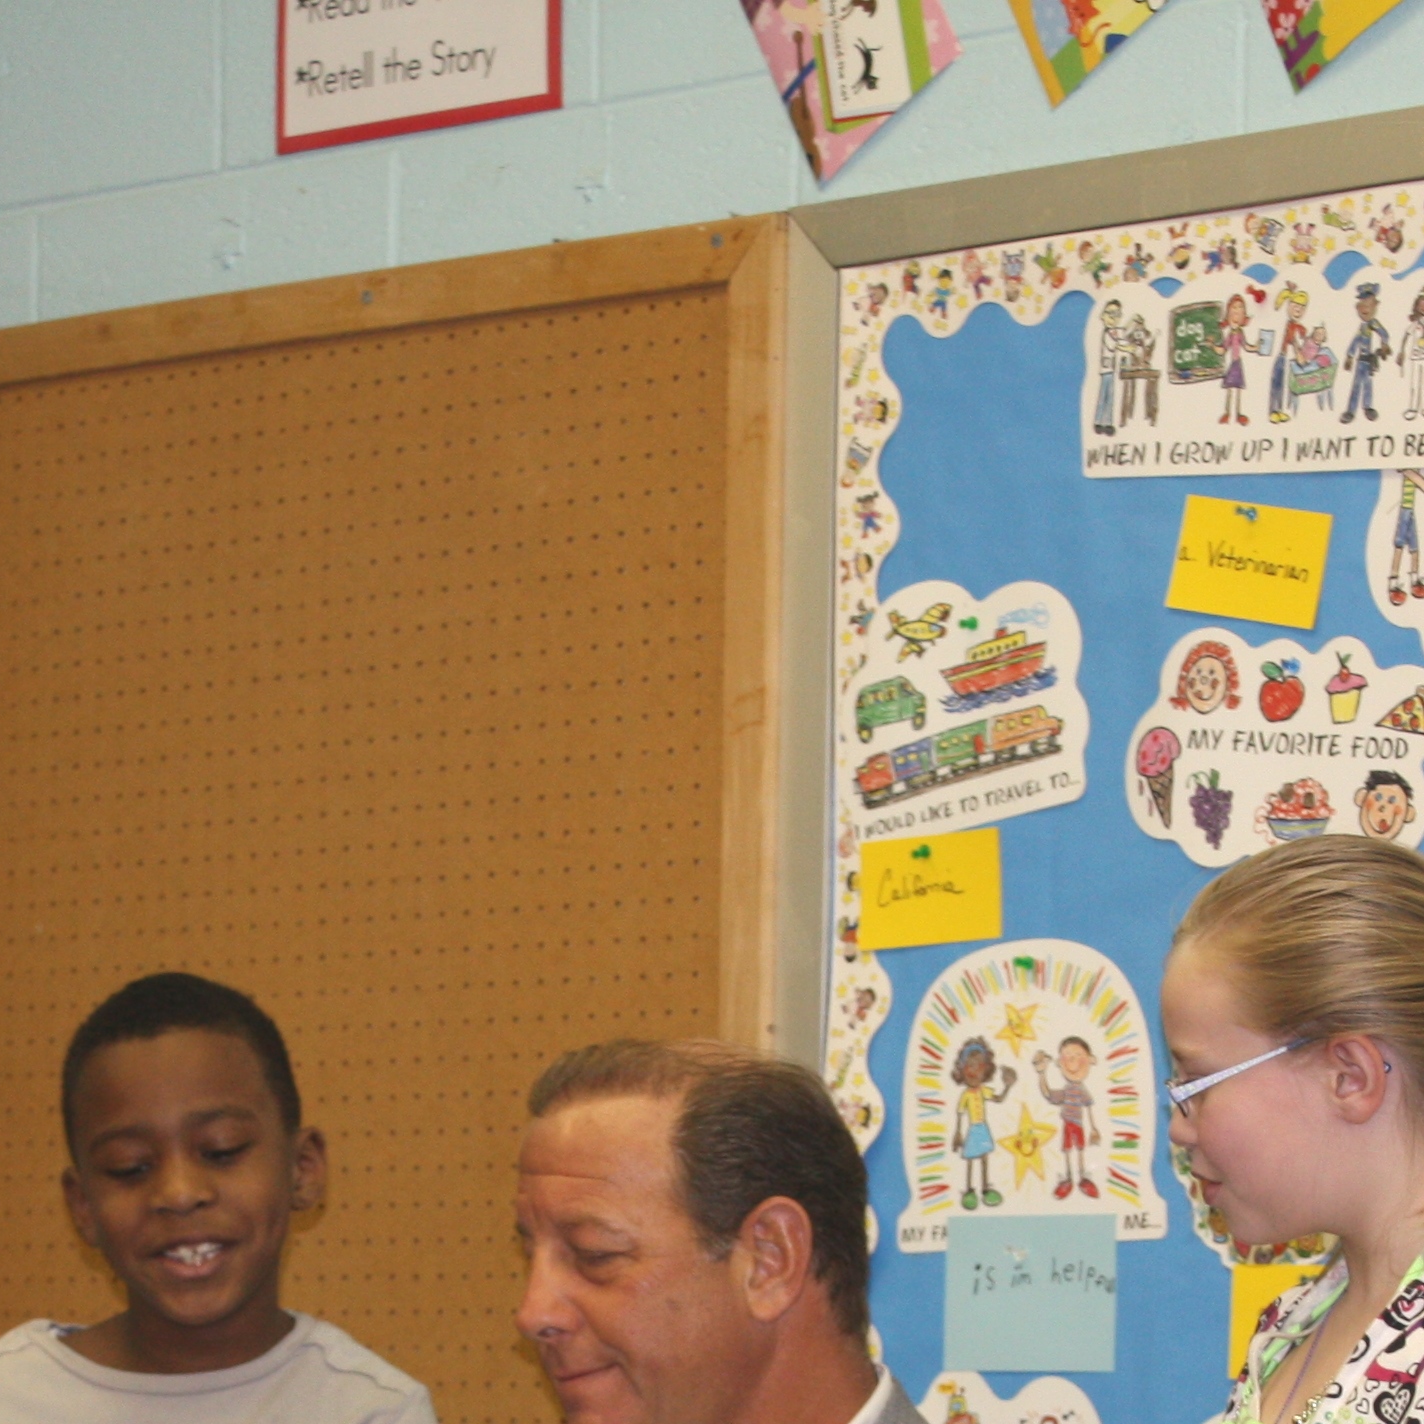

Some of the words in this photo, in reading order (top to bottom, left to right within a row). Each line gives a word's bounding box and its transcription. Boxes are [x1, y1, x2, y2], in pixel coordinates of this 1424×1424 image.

[382, 46, 422, 85] the
[430, 39, 497, 80] Story
[1176, 317, 1205, 344] dog
[1174, 345, 1199, 364] cat
[1087, 440, 1147, 470] WHEN
[1154, 441, 1161, 465] I
[1169, 441, 1234, 467] GROW
[1242, 437, 1274, 463] UP
[1282, 437, 1288, 461] I
[1296, 435, 1358, 462] WANT
[1367, 434, 1397, 459] TO
[1206, 539, 1310, 584] Veterinarian
[1186, 727, 1226, 751] MY
[1231, 729, 1343, 757] FAVORITE
[1349, 736, 1410, 761] FOOD
[854, 824, 862, 840] I
[863, 810, 916, 840] WOULD
[919, 801, 955, 826] LIKE
[959, 794, 979, 812] TO
[984, 781, 1046, 808] TRAVEL
[877, 866, 966, 909] California
[901, 1225, 925, 1244] MY
[973, 1263, 996, 1295] is
